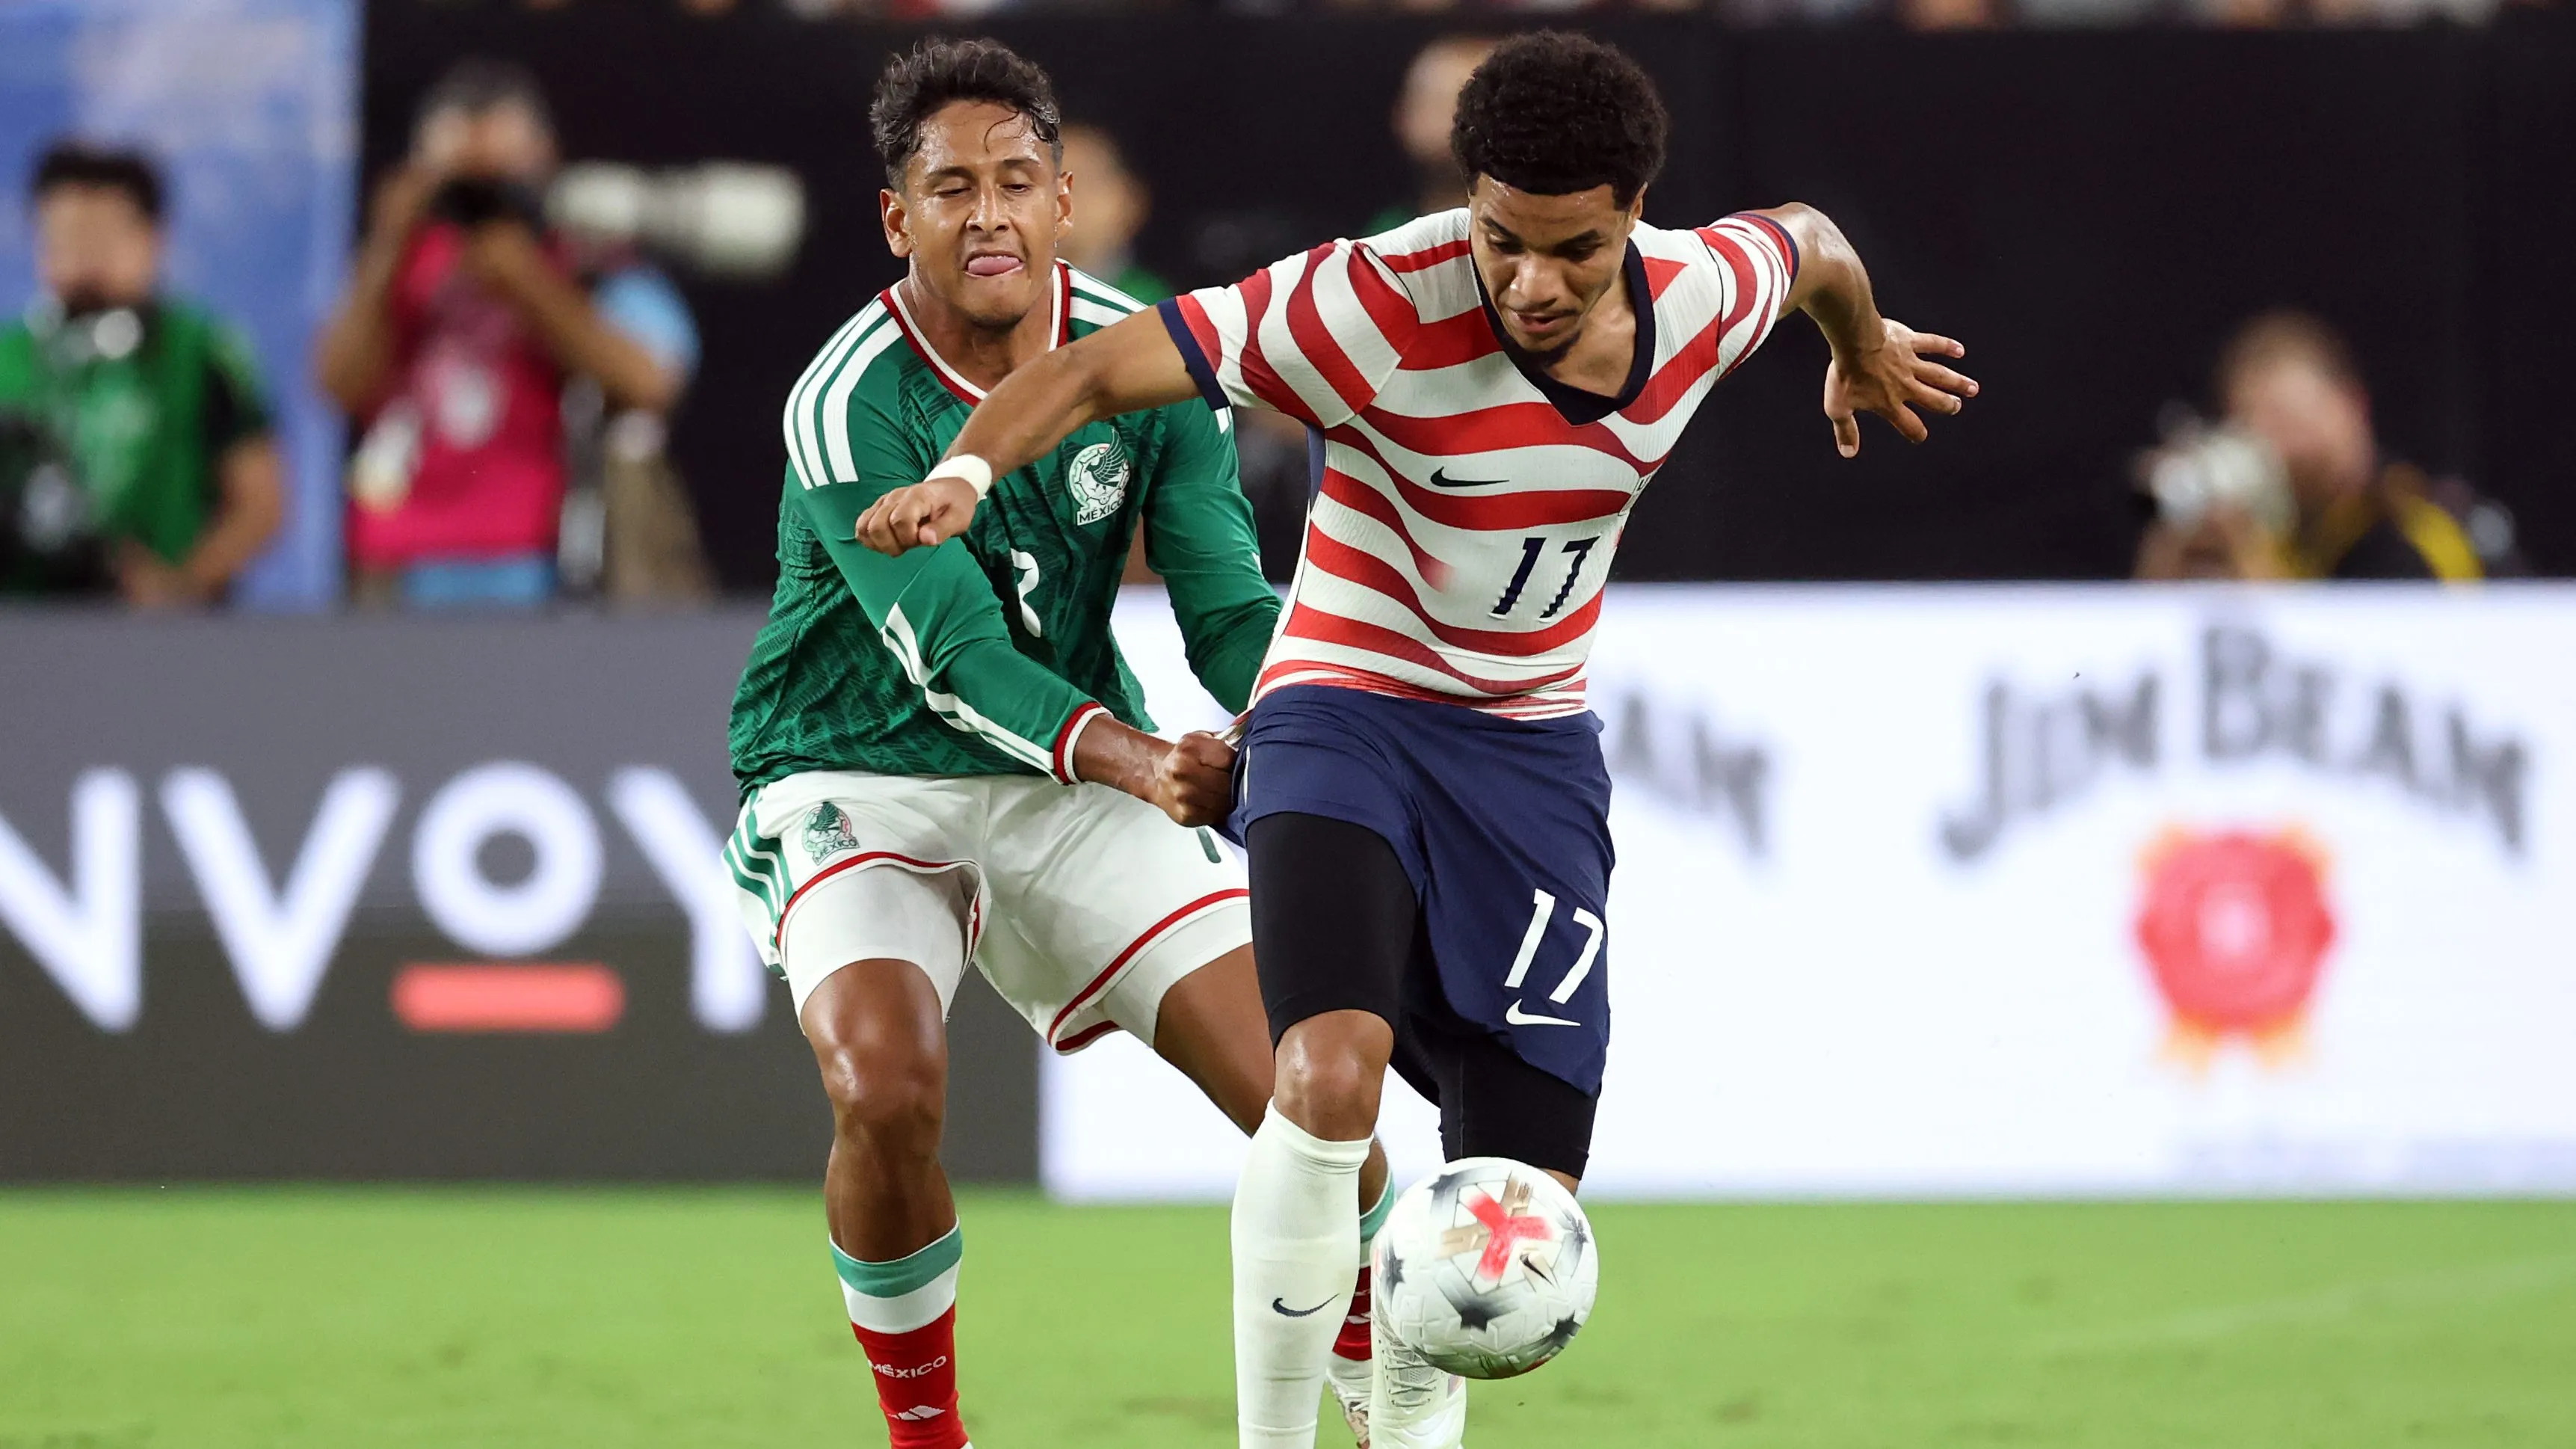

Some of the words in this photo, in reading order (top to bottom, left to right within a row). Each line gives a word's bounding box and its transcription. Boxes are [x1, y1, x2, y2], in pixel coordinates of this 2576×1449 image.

[1489, 536, 1600, 622] 17
[2202, 622, 2533, 861] BEAM
[1504, 887, 1604, 1004] 17
